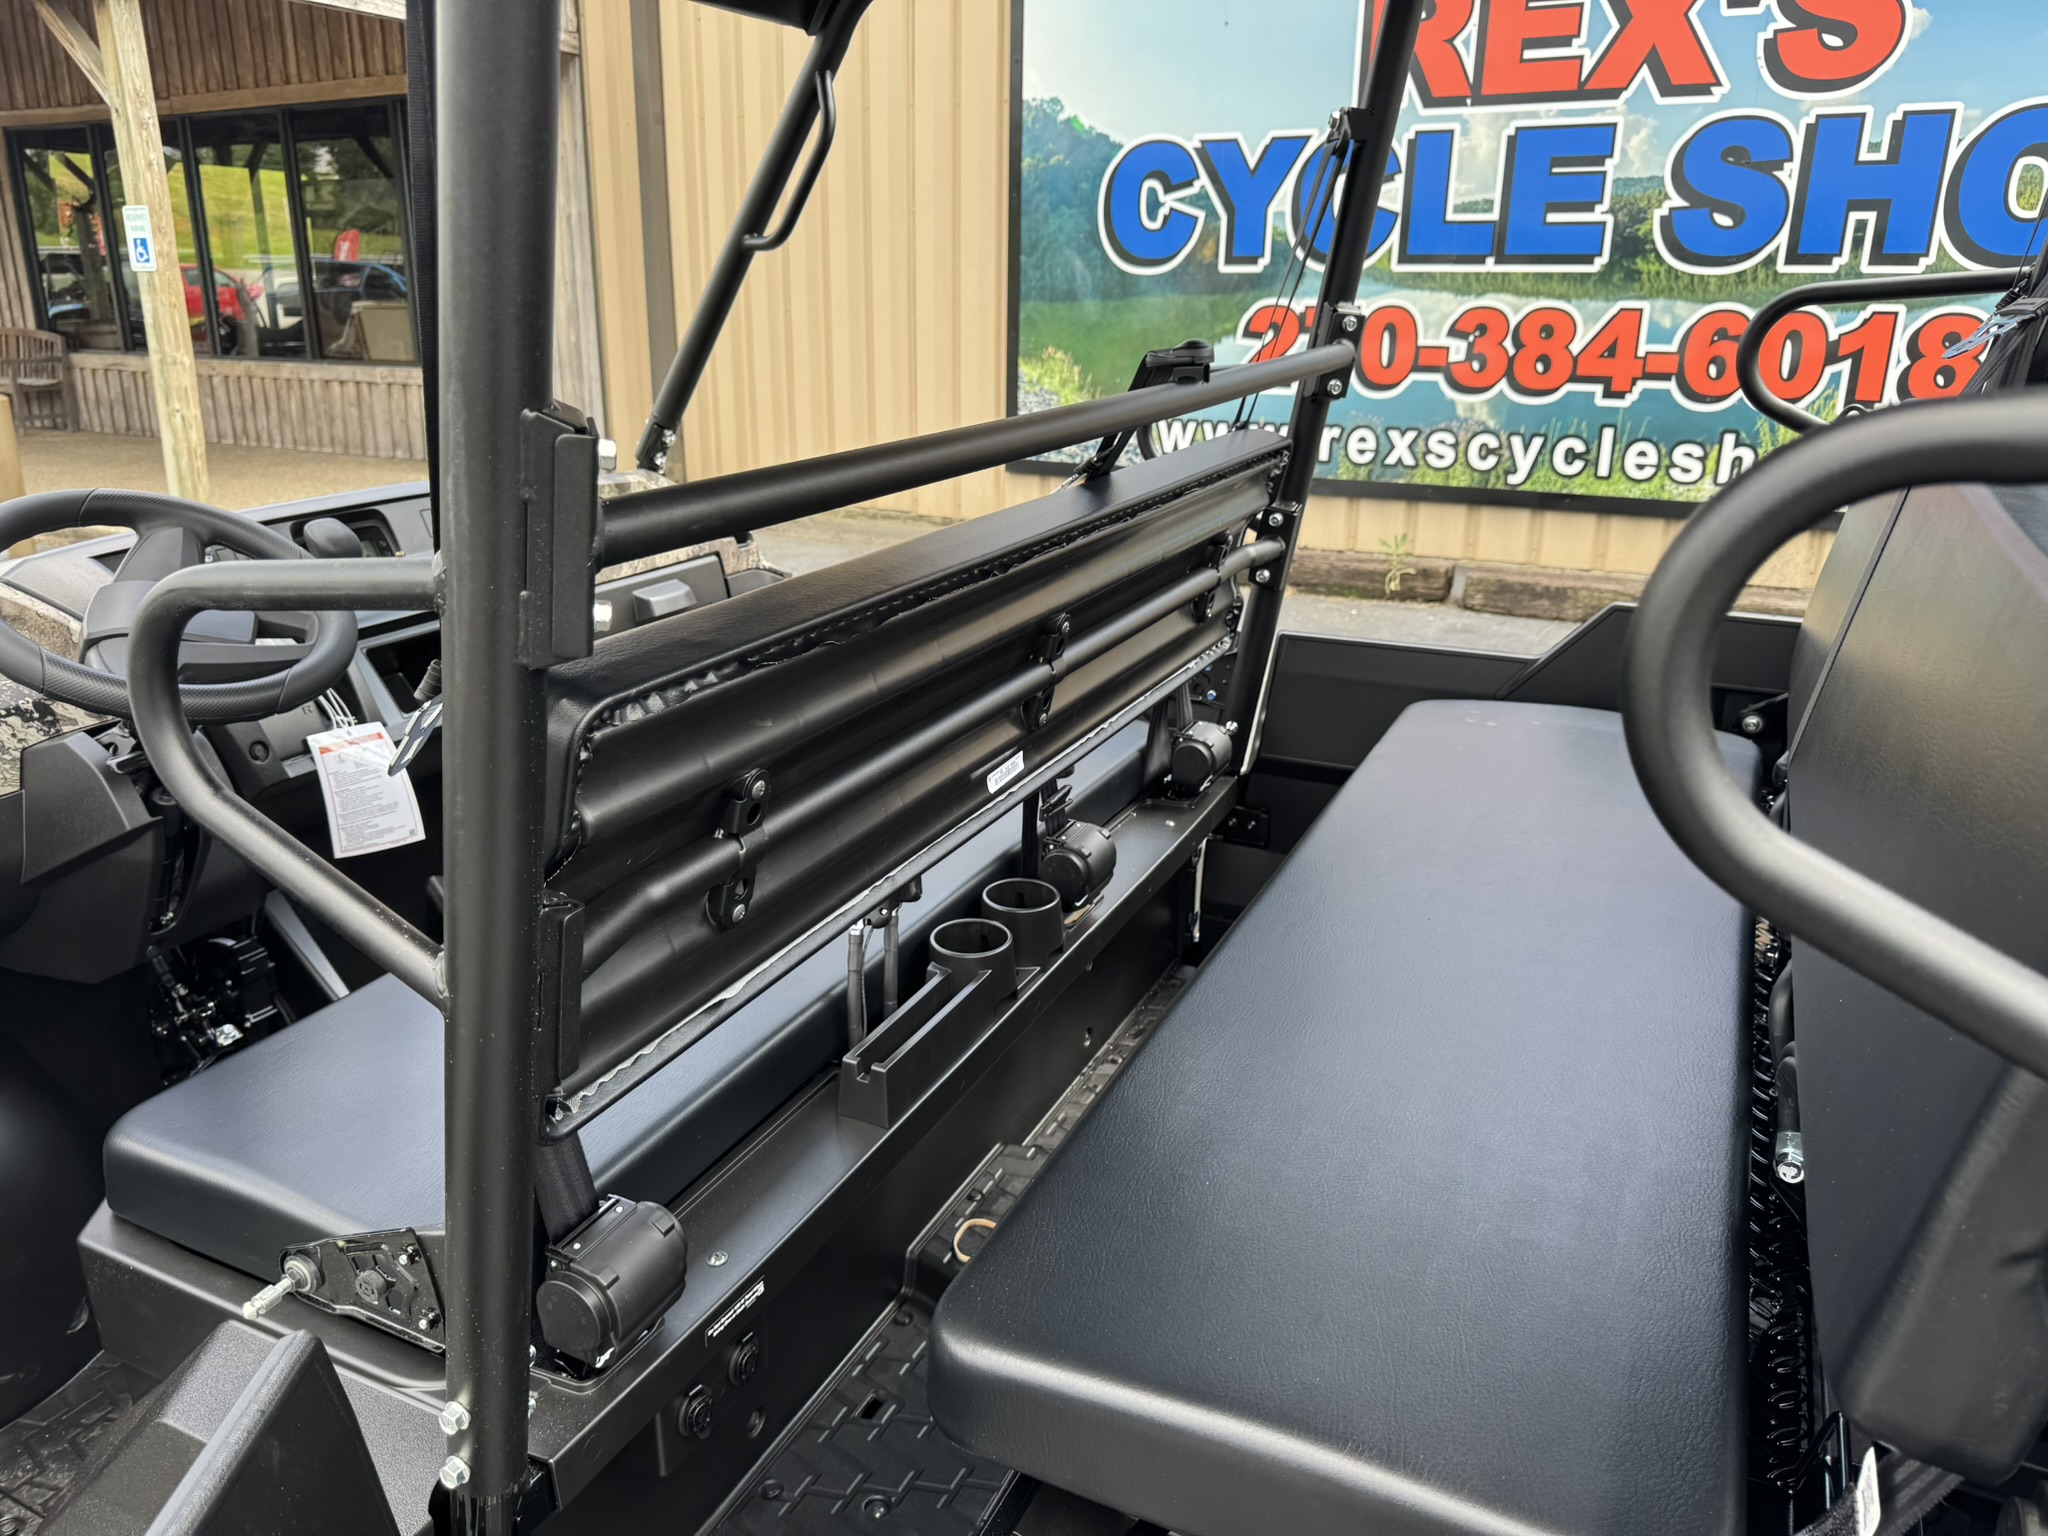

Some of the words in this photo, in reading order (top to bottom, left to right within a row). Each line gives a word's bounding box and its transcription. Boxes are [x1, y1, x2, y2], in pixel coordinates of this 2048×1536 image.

[1361, 0, 1907, 106] REXS
[1102, 122, 1620, 265] CYCLE
[1246, 303, 1990, 405] 20-384-6018
